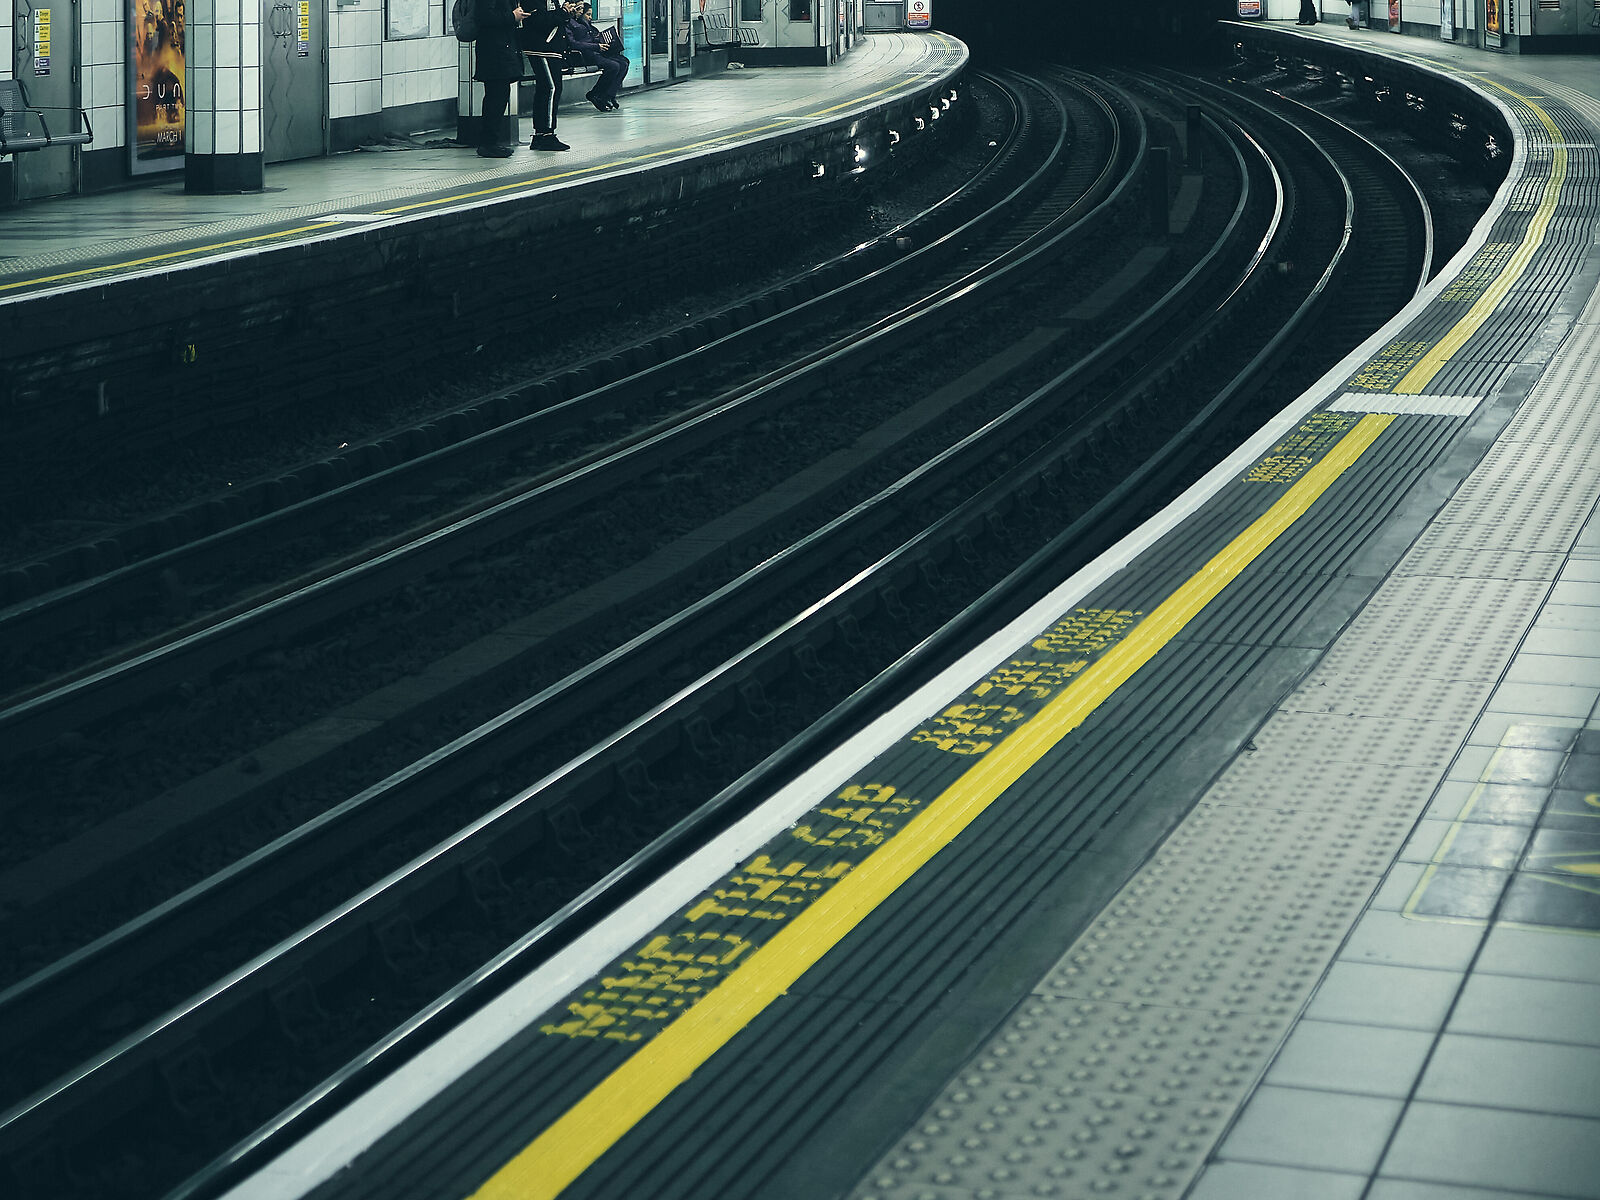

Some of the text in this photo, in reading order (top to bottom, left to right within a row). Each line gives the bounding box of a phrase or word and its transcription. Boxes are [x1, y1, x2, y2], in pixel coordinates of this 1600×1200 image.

[156, 130, 178, 143] MARCH
[540, 783, 920, 1042] MIND THE GAP
